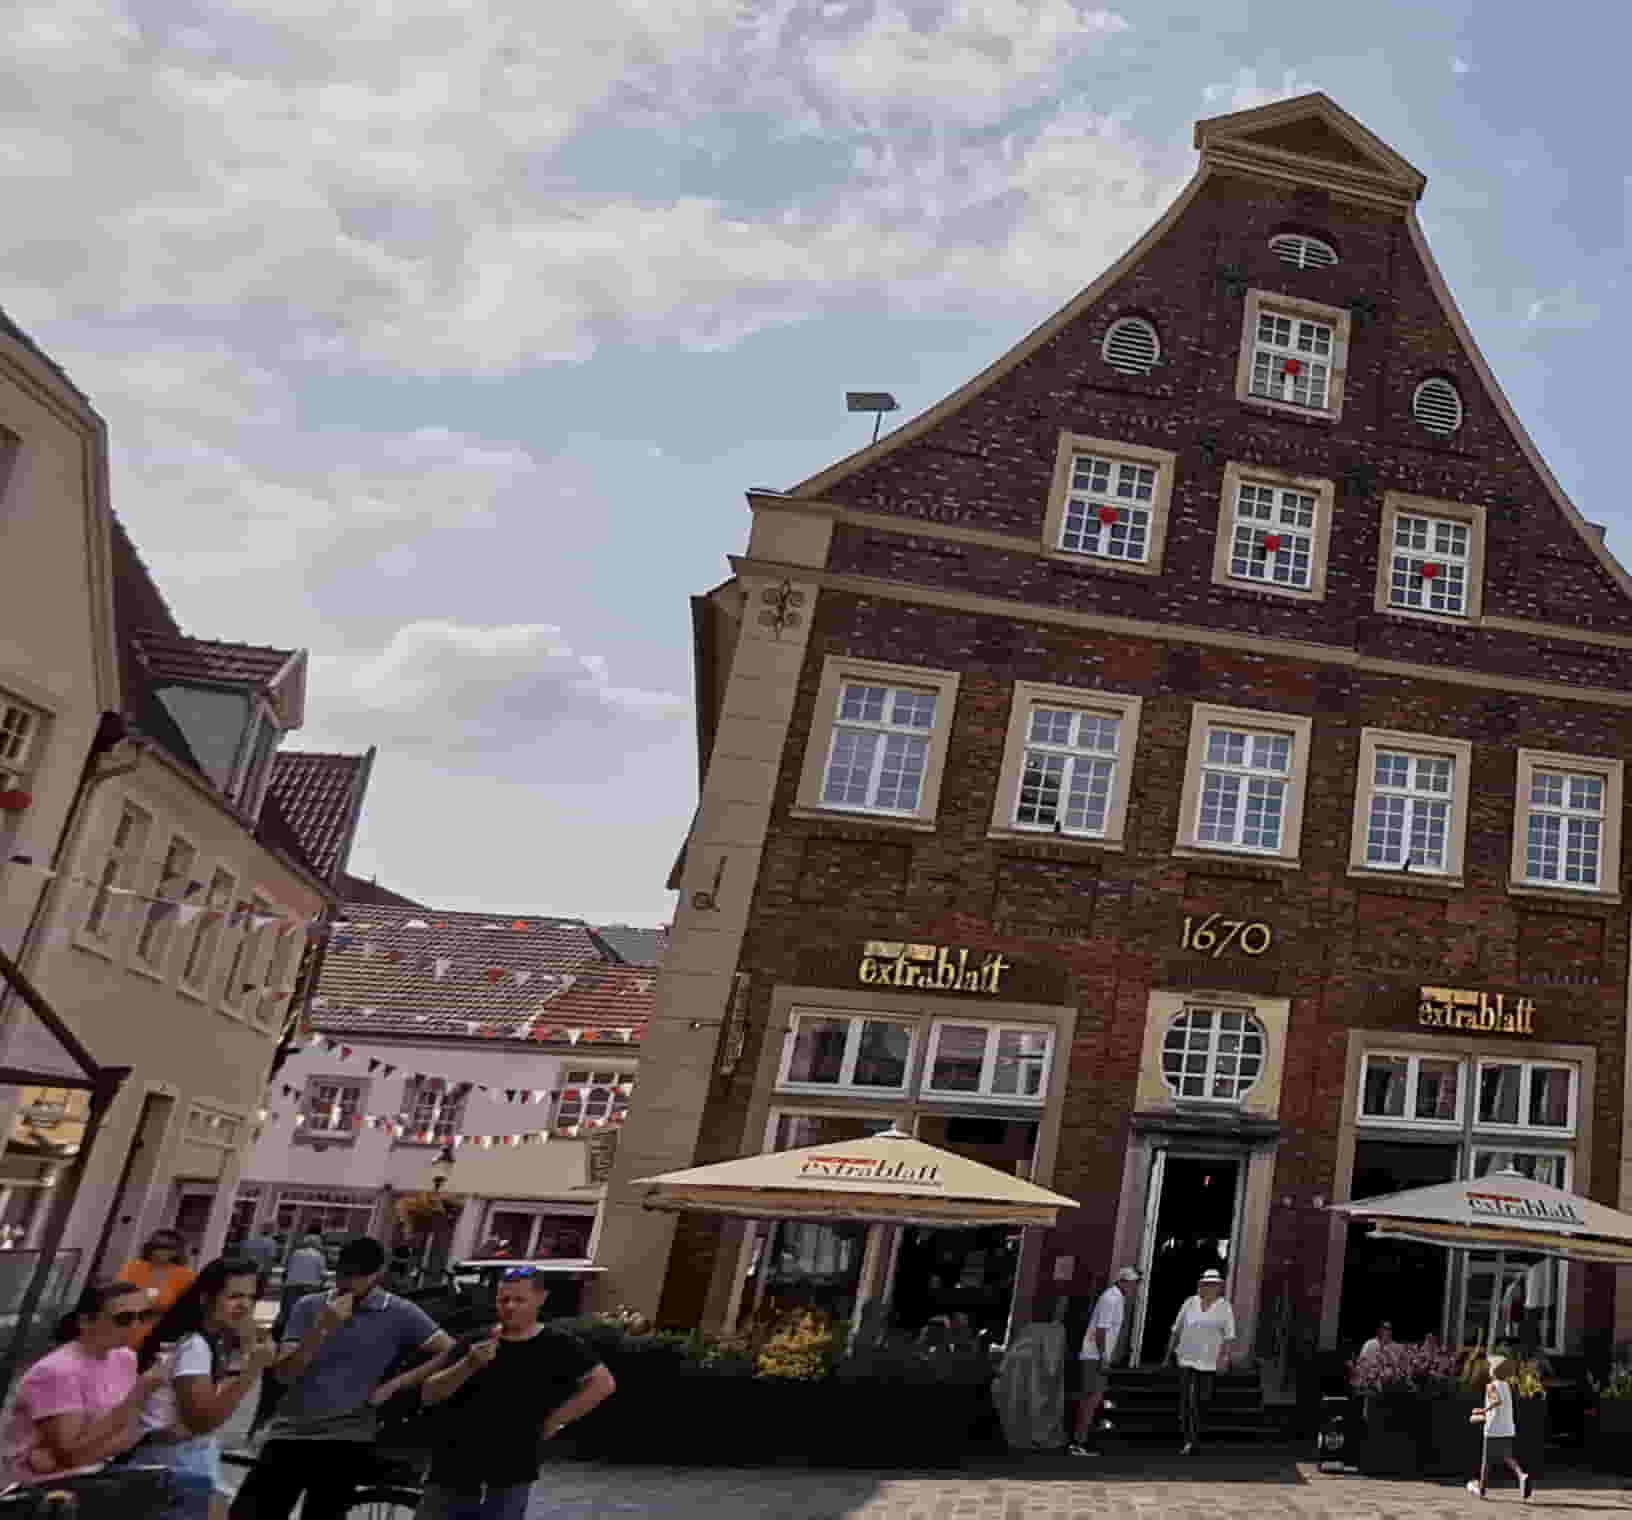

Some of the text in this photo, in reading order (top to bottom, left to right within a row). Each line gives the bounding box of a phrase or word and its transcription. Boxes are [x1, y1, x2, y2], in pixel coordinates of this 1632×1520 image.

[1182, 912, 1271, 957] 1670
[858, 944, 1010, 995] extrablatt
[1417, 990, 1537, 1034] extrablatt
[800, 1157, 940, 1183] extrablatt
[1465, 1196, 1577, 1218] extrablatt
